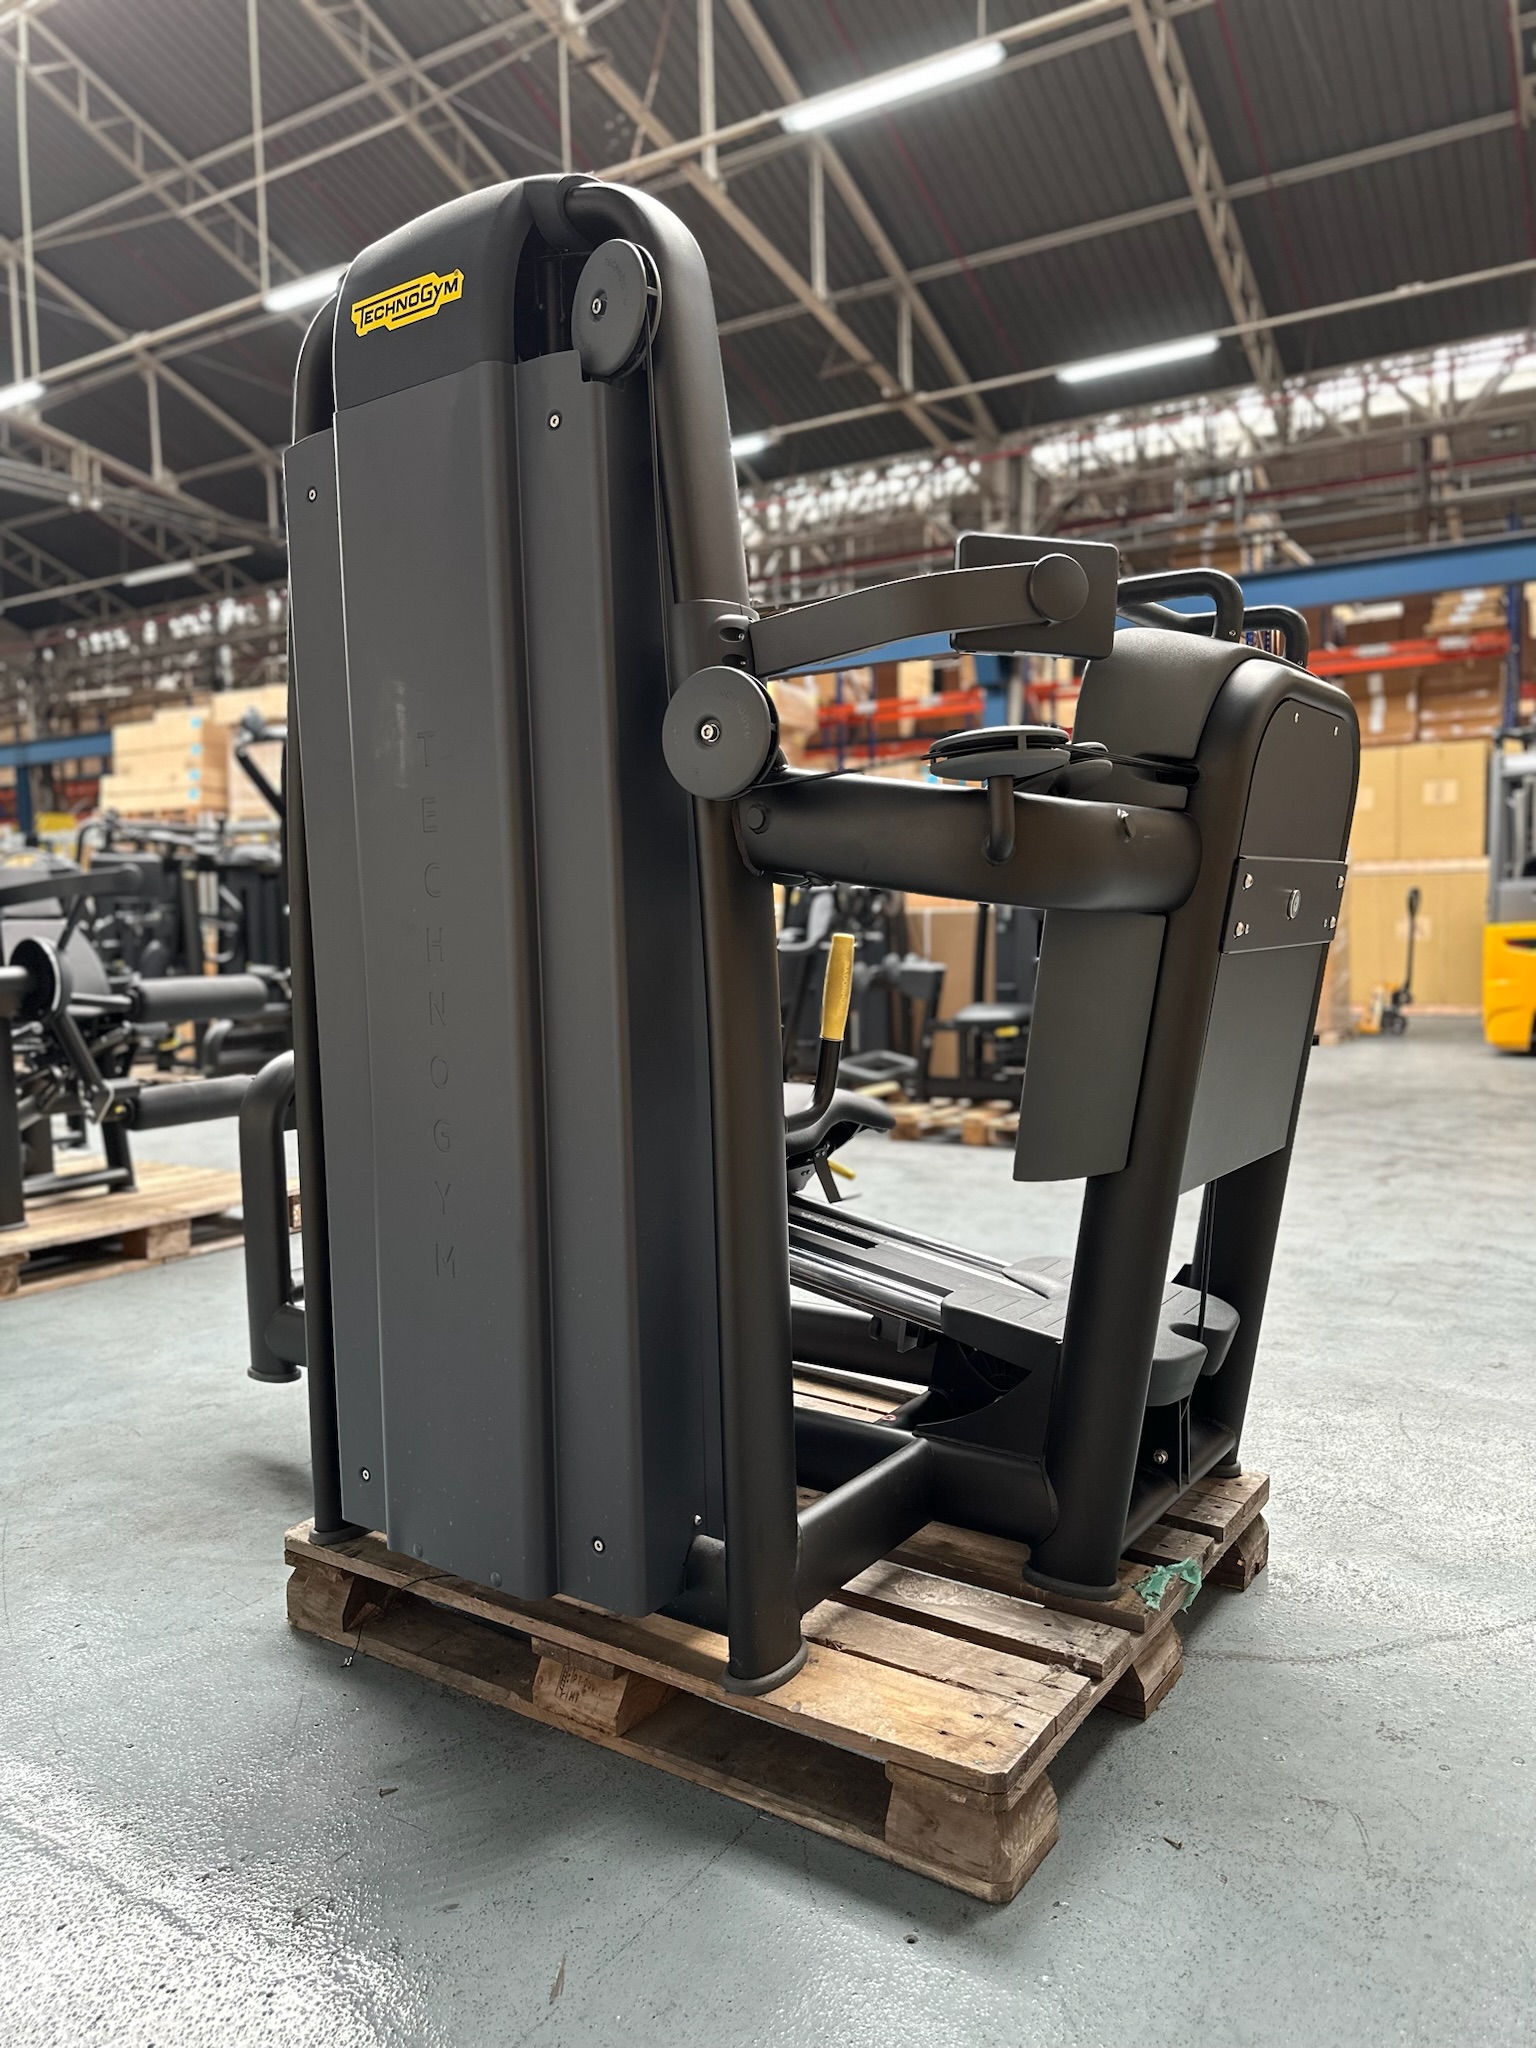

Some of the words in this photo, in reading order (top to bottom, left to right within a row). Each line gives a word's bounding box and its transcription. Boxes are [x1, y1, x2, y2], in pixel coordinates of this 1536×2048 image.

[354, 277, 459, 329] TECHNOGYM
[716, 685, 752, 739] ECHNOGYM
[416, 730, 457, 1279] TECHNOGYM
